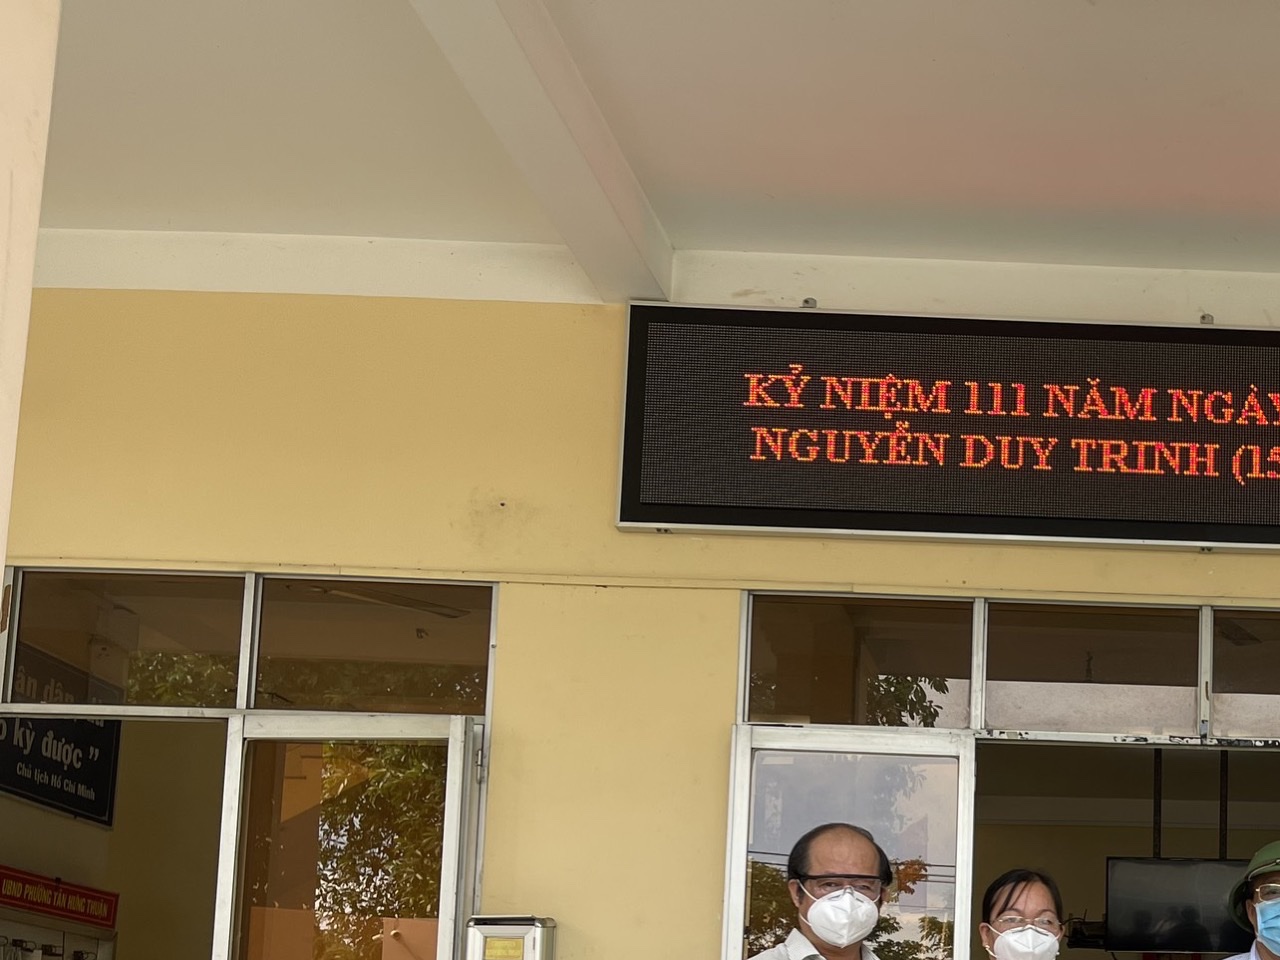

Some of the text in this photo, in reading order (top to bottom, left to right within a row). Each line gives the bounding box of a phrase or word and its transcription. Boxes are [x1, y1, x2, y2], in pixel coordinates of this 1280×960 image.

[743, 363, 812, 408] KỶ
[819, 373, 952, 420] NIỆM
[963, 380, 1031, 417] 111
[1042, 377, 1159, 422] NĂM
[750, 420, 951, 467] NGUYỄN
[959, 434, 1059, 471] DUY
[1070, 438, 1221, 477] TRINH
[41, 730, 83, 771] được
[17, 762, 96, 801] Chủ tịch Hồ Chí Minh
[2, 879, 23, 898] UBND
[24, 884, 53, 905] PHƯỜNG
[53, 889, 67, 909] TÂN
